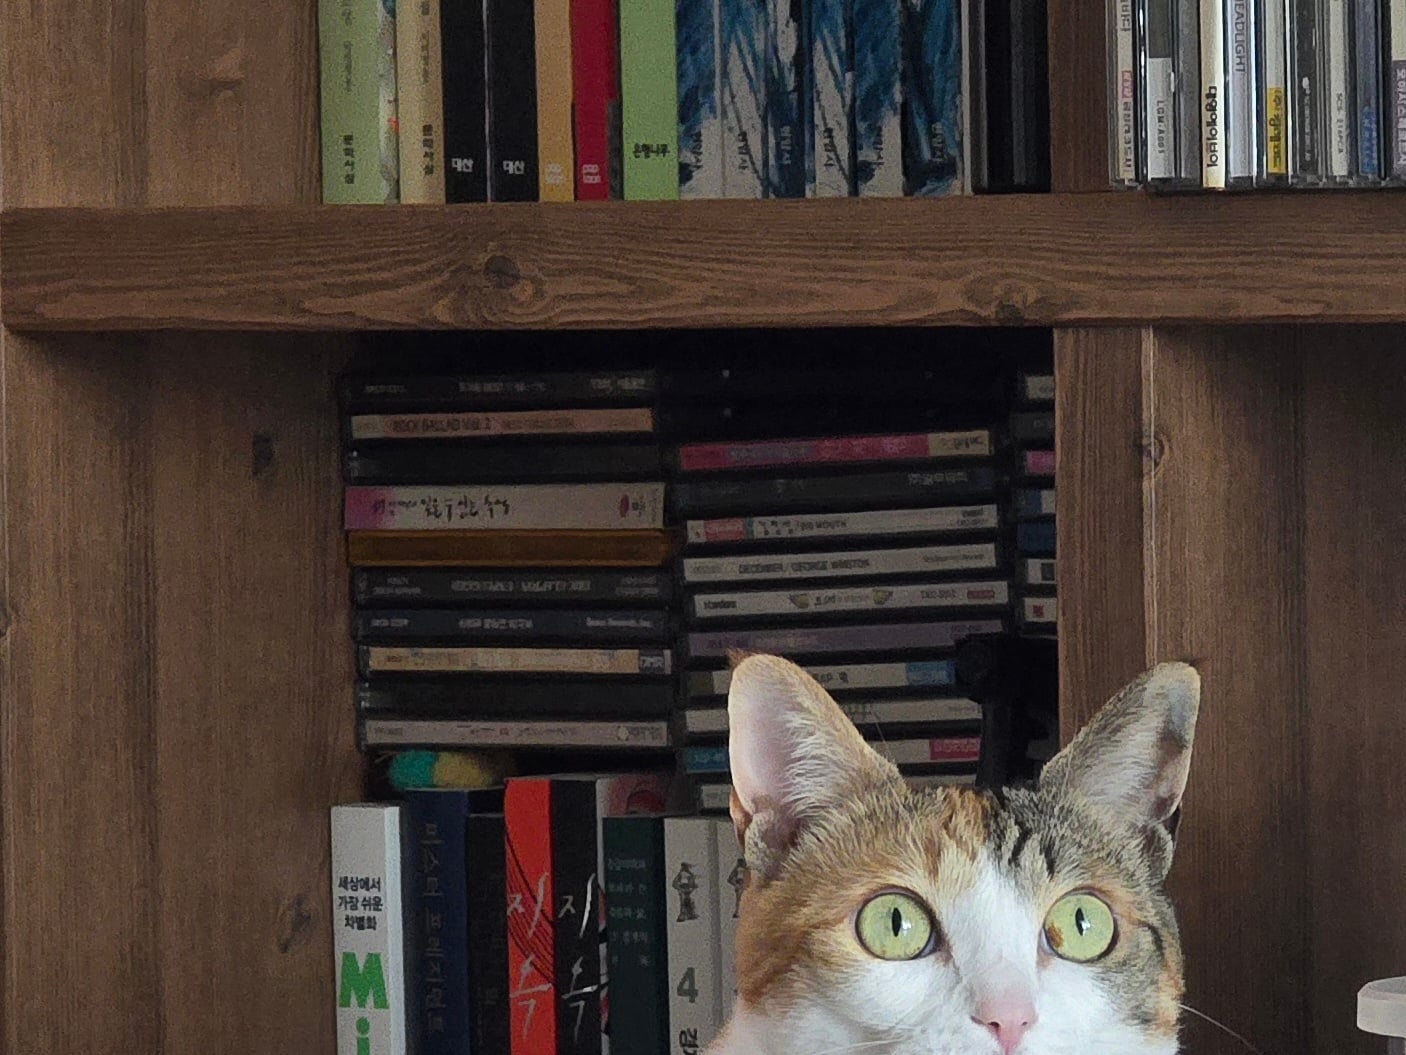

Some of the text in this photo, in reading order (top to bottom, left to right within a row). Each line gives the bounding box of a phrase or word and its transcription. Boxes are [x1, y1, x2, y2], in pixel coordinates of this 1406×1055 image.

[423, 822, 445, 897] 미스터
[338, 876, 381, 892] 세상에서
[338, 896, 383, 913] 가장 쉬운
[344, 915, 378, 931] 차별화
[676, 966, 699, 1004] 4
